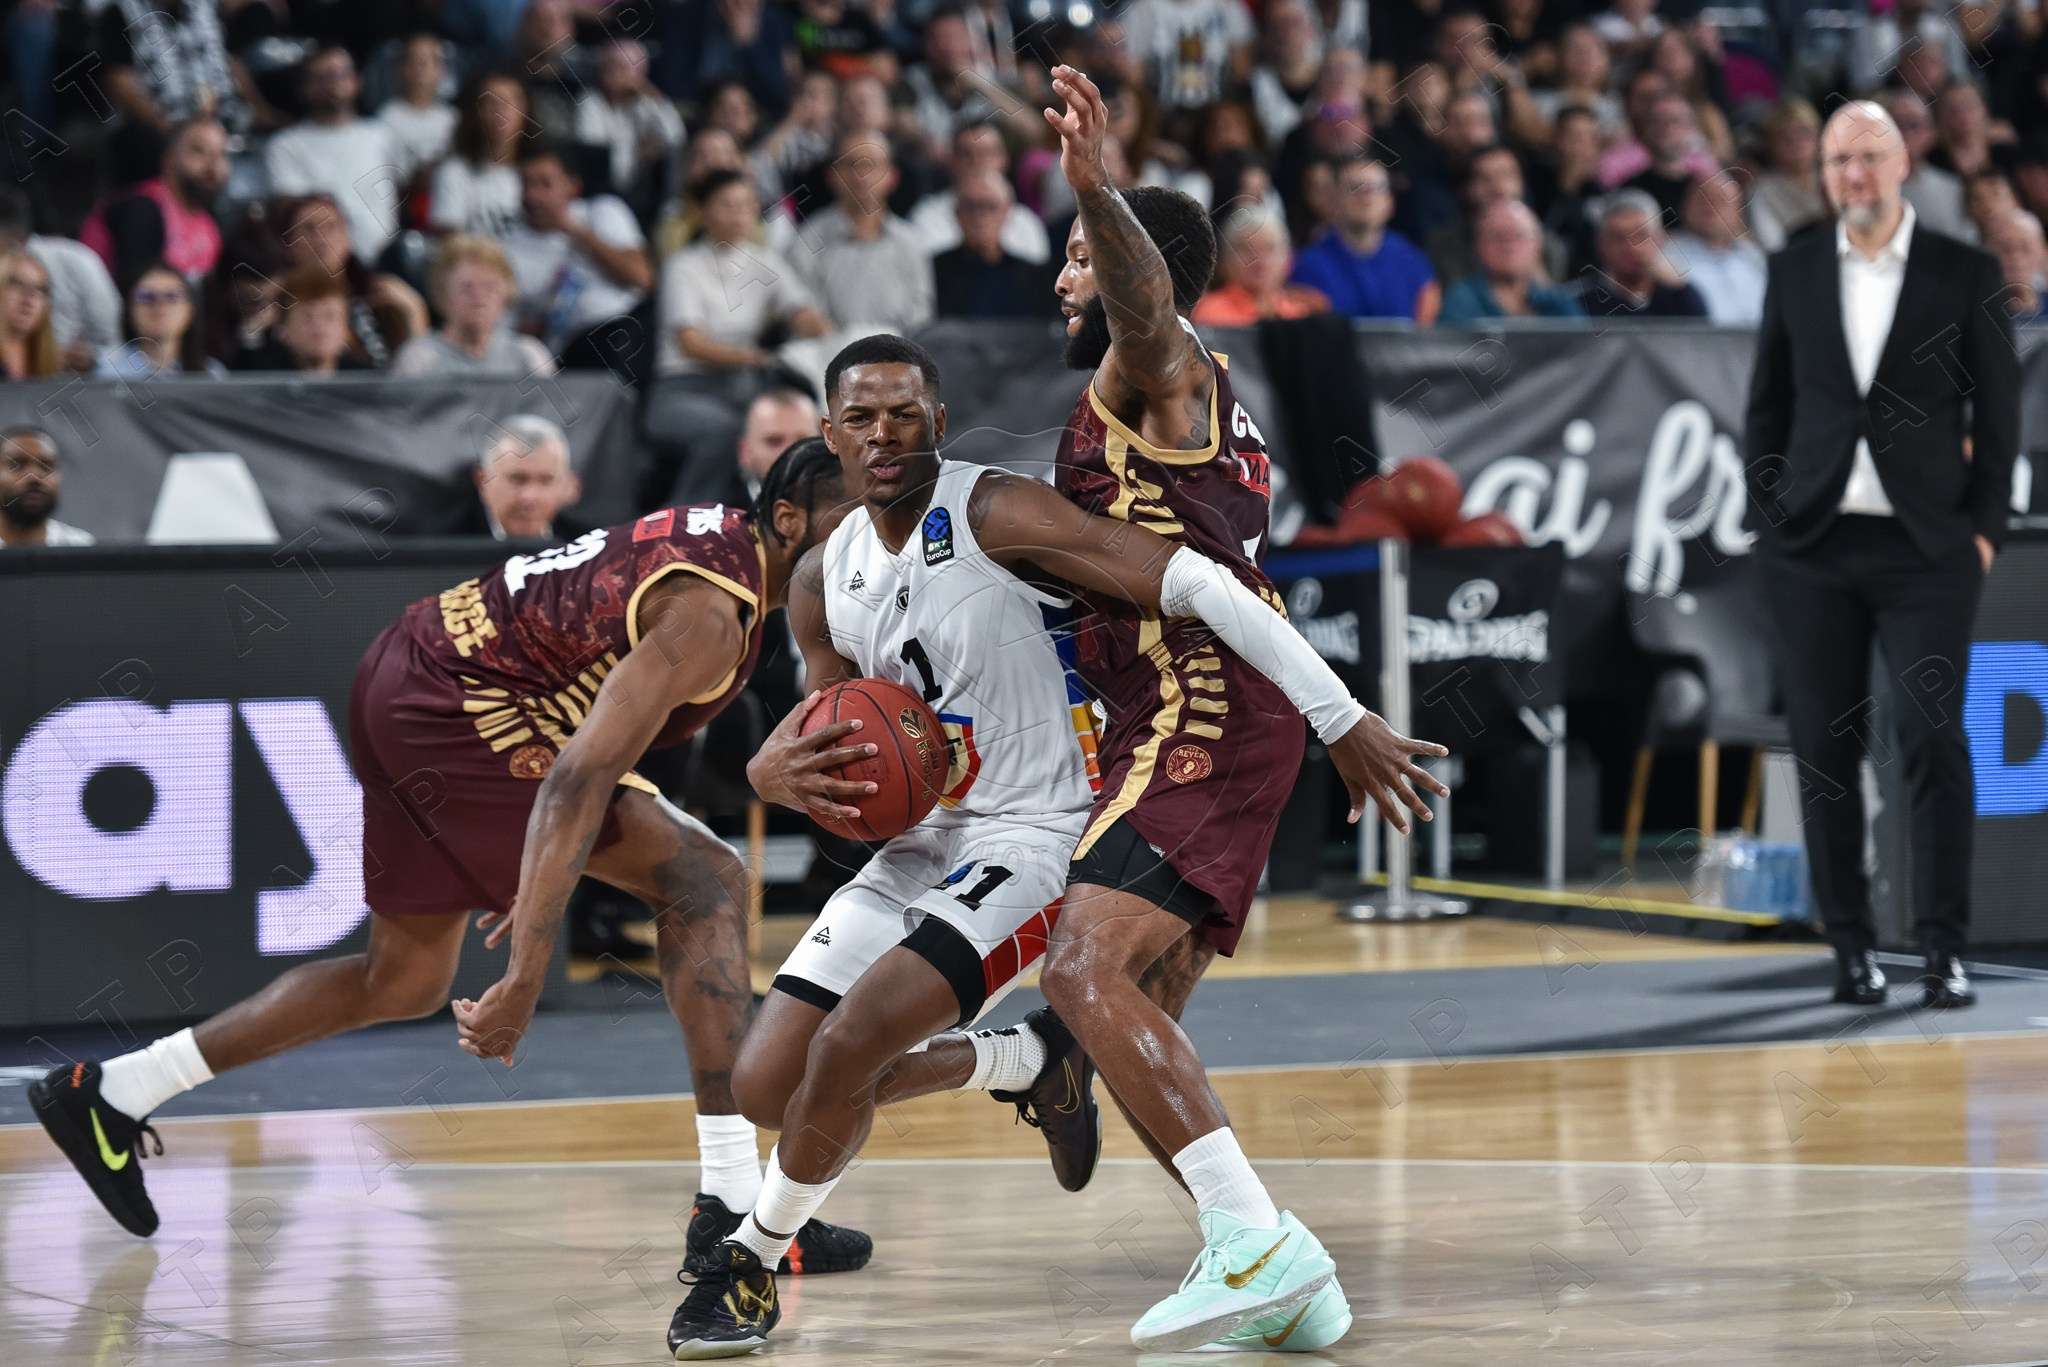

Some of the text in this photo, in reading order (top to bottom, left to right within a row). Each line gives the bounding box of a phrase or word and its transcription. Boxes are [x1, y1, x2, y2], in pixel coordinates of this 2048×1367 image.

[928, 540, 948, 553] BKT
[926, 547, 952, 561] EuroCup
[849, 581, 865, 592] PEAK
[900, 637, 943, 703] 1
[1178, 749, 1205, 759] REYER
[953, 865, 1014, 912] 1
[811, 935, 832, 947] PEAK
